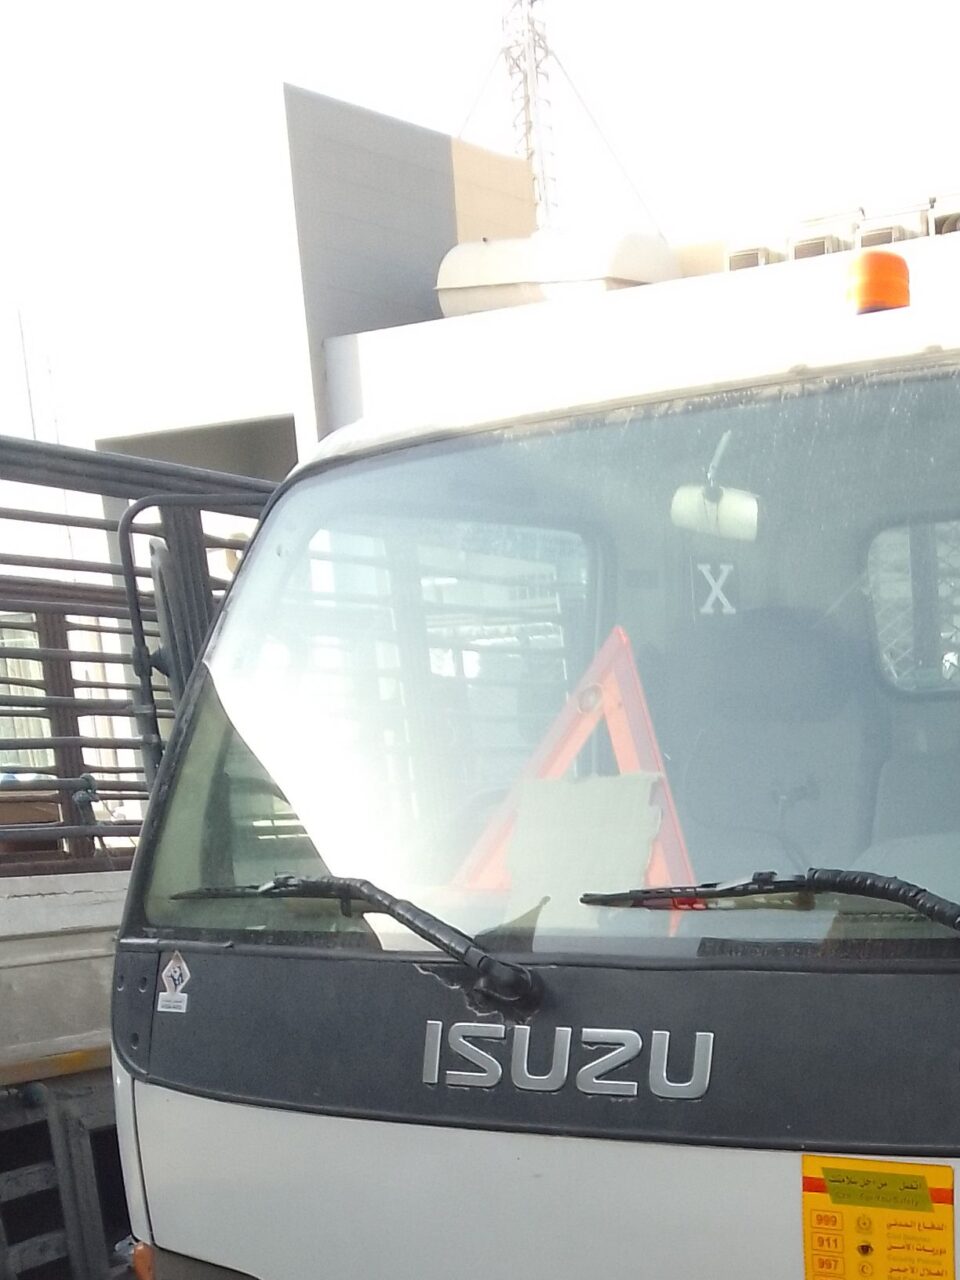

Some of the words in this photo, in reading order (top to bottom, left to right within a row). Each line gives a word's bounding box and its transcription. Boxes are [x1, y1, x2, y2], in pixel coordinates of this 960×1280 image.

[697, 563, 736, 614] X
[422, 1020, 714, 1099] ISUZU
[817, 1236, 839, 1249] 911
